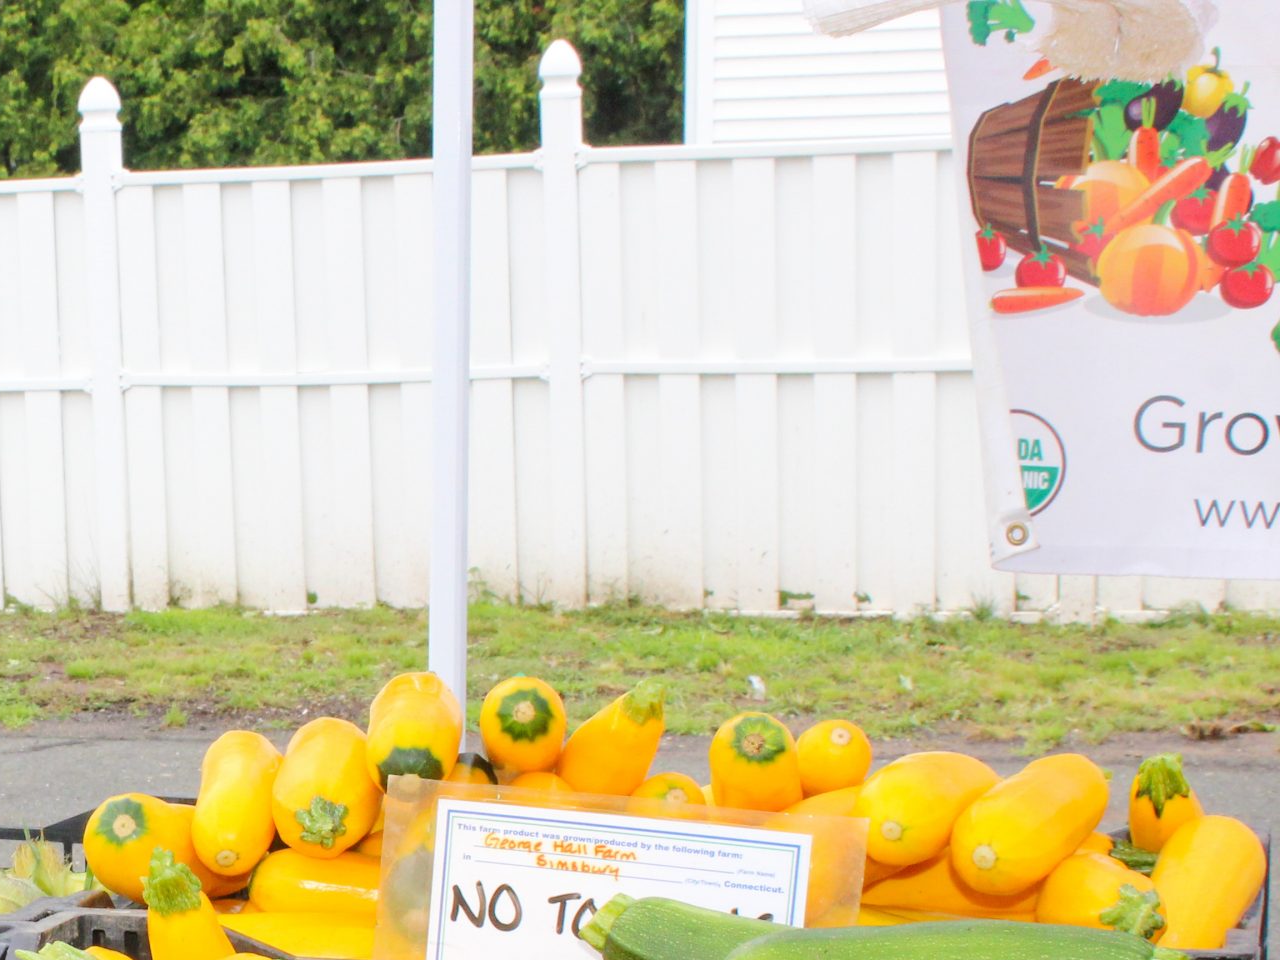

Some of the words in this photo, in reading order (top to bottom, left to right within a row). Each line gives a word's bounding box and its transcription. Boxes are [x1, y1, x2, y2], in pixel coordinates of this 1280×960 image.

[1134, 395, 1280, 455] Gro
[457, 823, 477, 832] This
[480, 825, 501, 834] farm
[503, 828, 540, 839] product
[542, 832, 561, 840] was
[563, 835, 638, 848] grown/produced
[640, 841, 652, 851] by
[654, 843, 670, 851] the
[672, 845, 716, 858] following
[718, 850, 743, 860] farm:
[484, 832, 543, 853] George
[553, 841, 588, 855] Hall
[594, 844, 637, 861] Farm
[724, 880, 784, 894] Connecticut.
[451, 880, 523, 932] NO
